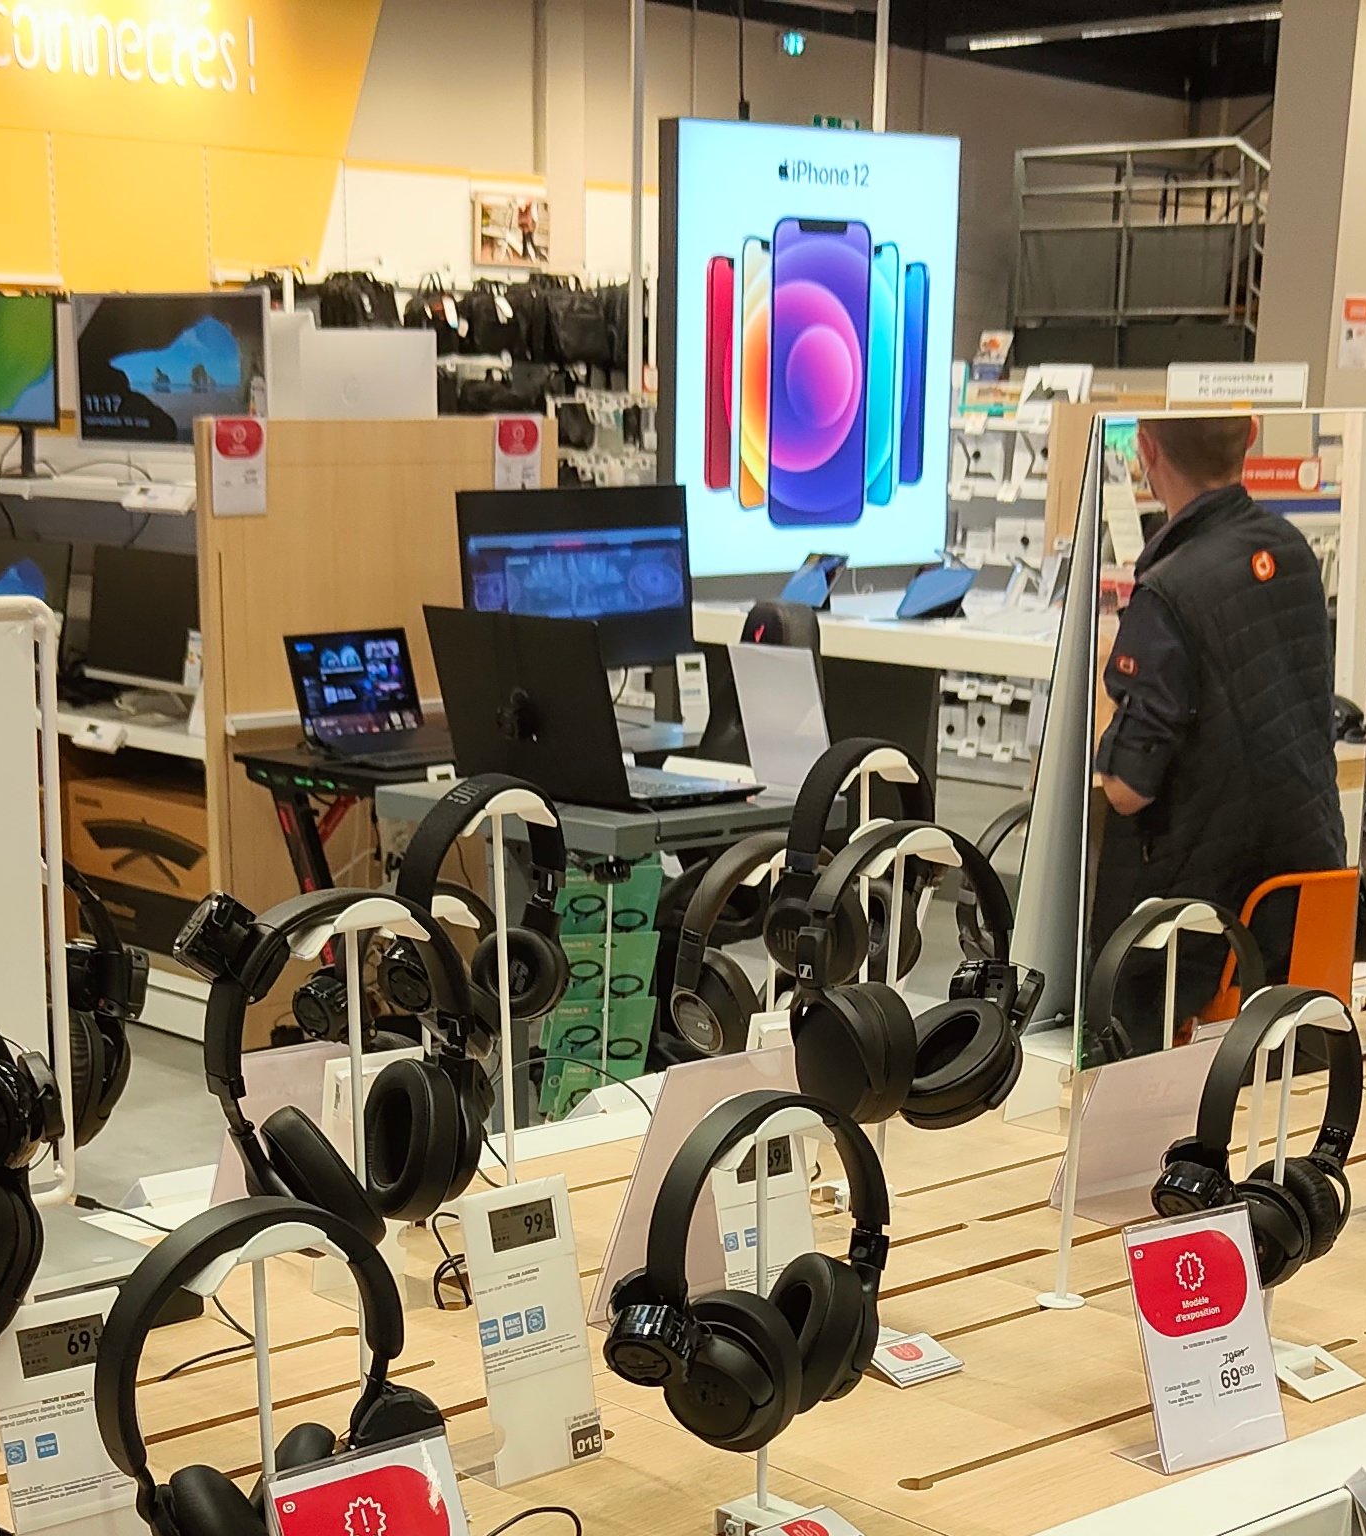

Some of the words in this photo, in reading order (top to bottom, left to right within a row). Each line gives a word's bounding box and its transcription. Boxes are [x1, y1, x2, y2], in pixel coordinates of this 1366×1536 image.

[793, 159, 849, 186] iPhone
[855, 163, 869, 186] 12
[524, 1214, 543, 1234] 99
[1182, 1296, 1209, 1309] Modèle
[1175, 1306, 1220, 1323] d'exposition
[68, 1331, 90, 1355] 69
[1221, 1364, 1255, 1388] 69€99
